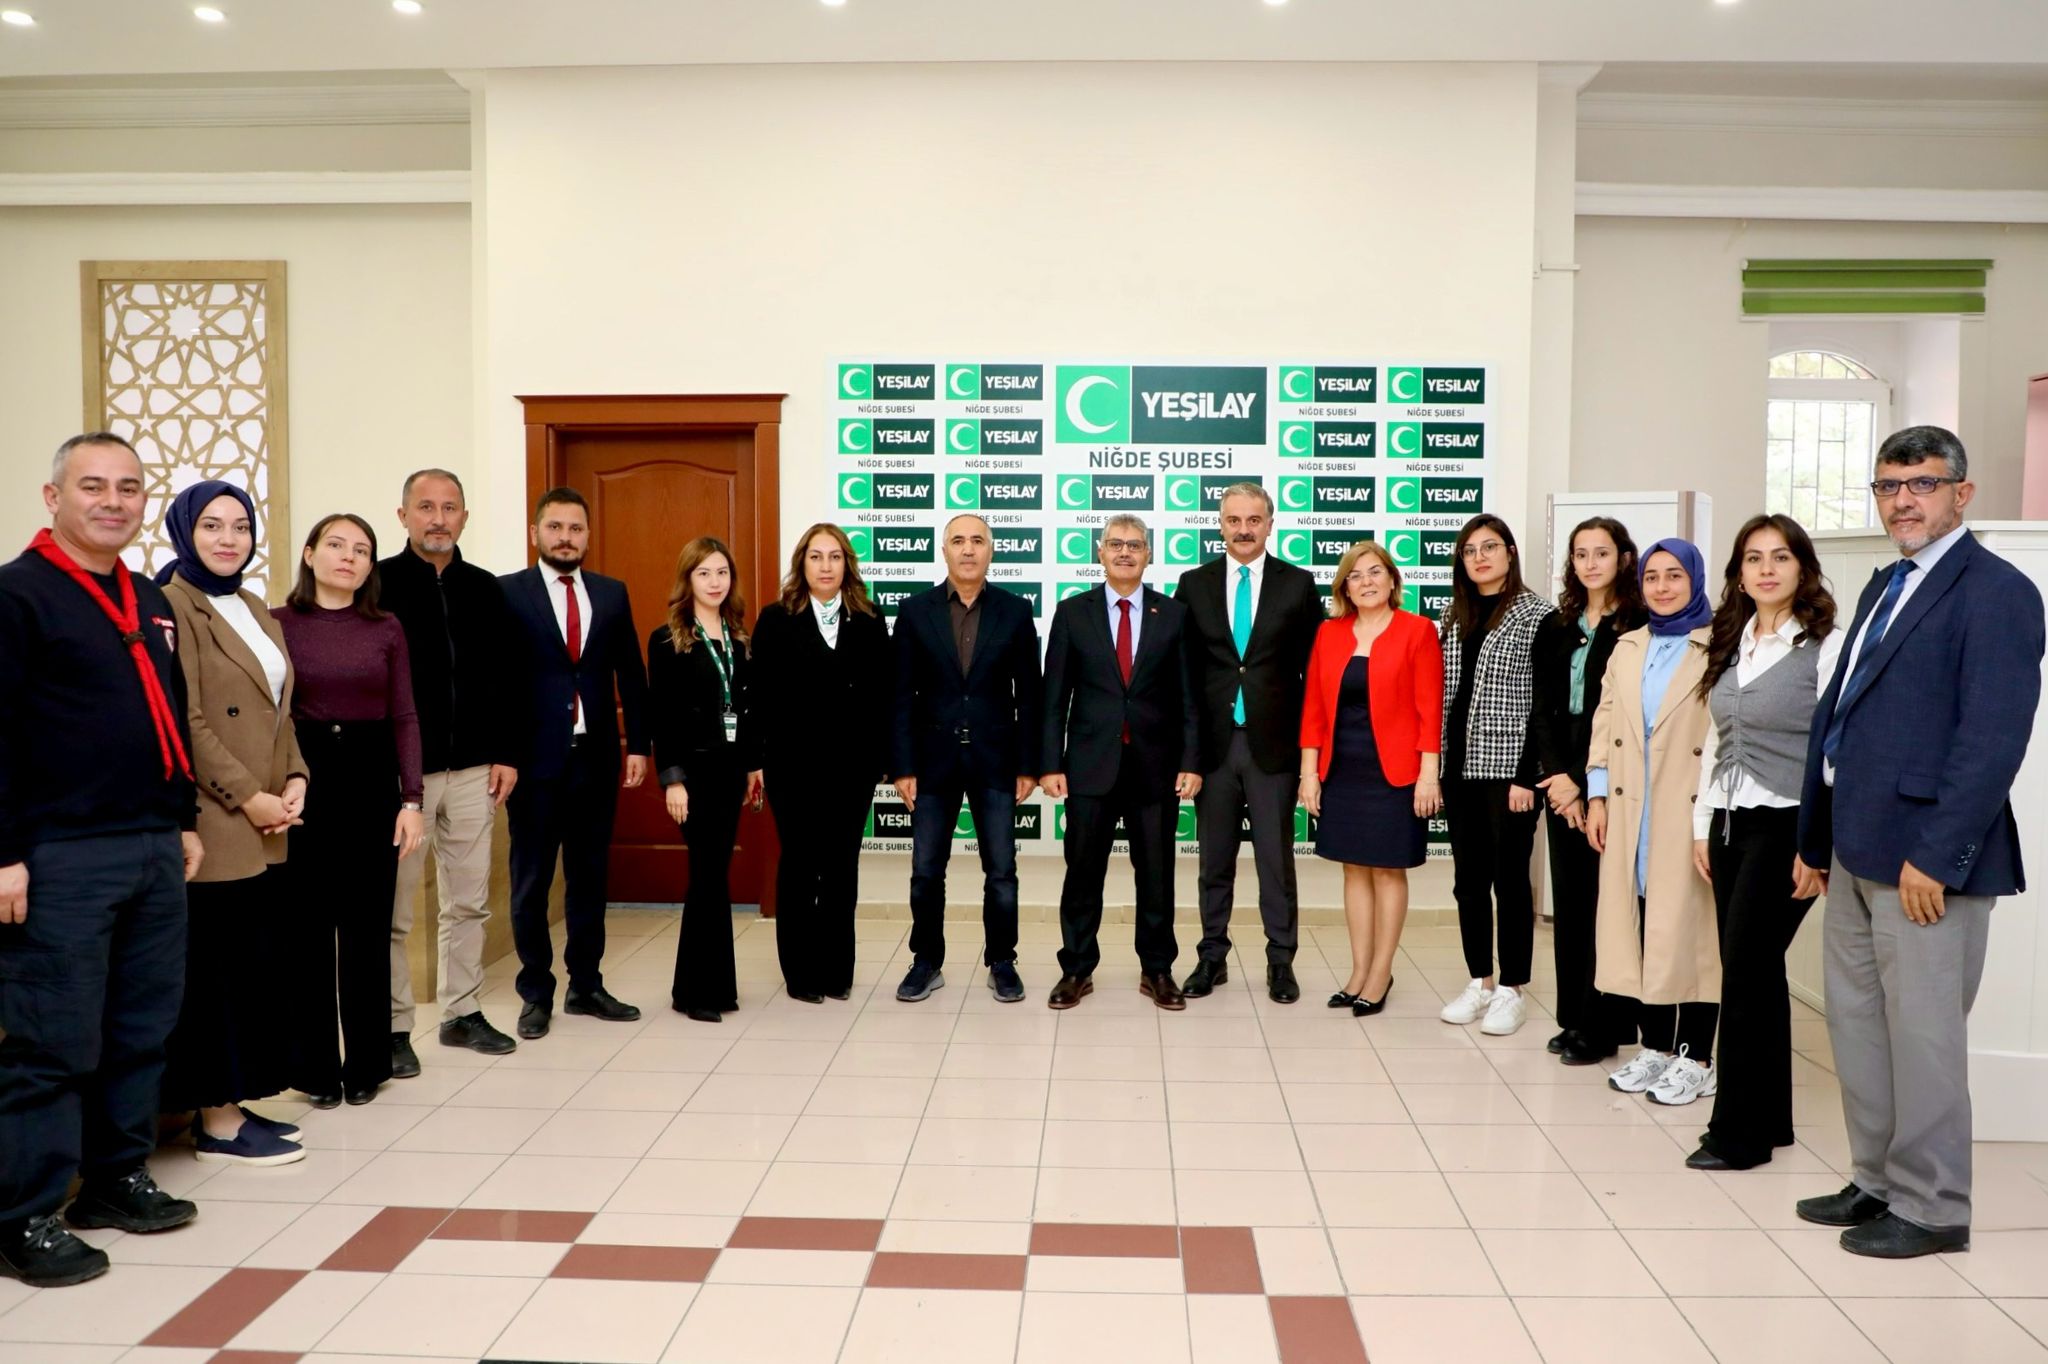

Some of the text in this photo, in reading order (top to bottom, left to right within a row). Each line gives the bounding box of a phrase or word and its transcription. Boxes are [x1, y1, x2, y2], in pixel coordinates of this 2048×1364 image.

[858, 404, 915, 415] NİĞDE ŞUBESİ
[965, 405, 1023, 415] NİĞDE ŞUBESİ
[1299, 407, 1357, 417] NİĞDE ŞUBESİ
[1407, 407, 1465, 418] NİĞDE ŞUBESİ
[1089, 446, 1232, 472] NİĞDE ŞUBESİ
[858, 459, 915, 470] NİĞDE ŞUBESİ
[965, 459, 1023, 470] NİĞDE ŞUBESİ
[1298, 462, 1356, 472] NİĞDE ŞUBESİ
[1406, 463, 1464, 473] NİĞDE ŞUBESİ
[858, 513, 915, 524] NİĞDE ŞUBESİ
[992, 514, 1023, 524] ŞUBESİ
[1076, 514, 1102, 524] NİĞDE
[1184, 515, 1210, 525] NİĞDE
[1297, 516, 1355, 527] NİĞDE ŞUBESİ
[1405, 517, 1463, 528] NİĞDE ŞUBESİ
[885, 566, 915, 576] ŞUBESİ
[992, 567, 1023, 577] ŞUBESİ
[1076, 568, 1101, 578] NİĞDE
[1404, 569, 1430, 579] NİĞDE
[885, 842, 913, 852] ŞUBES
[1426, 848, 1453, 856] ŞUBES
